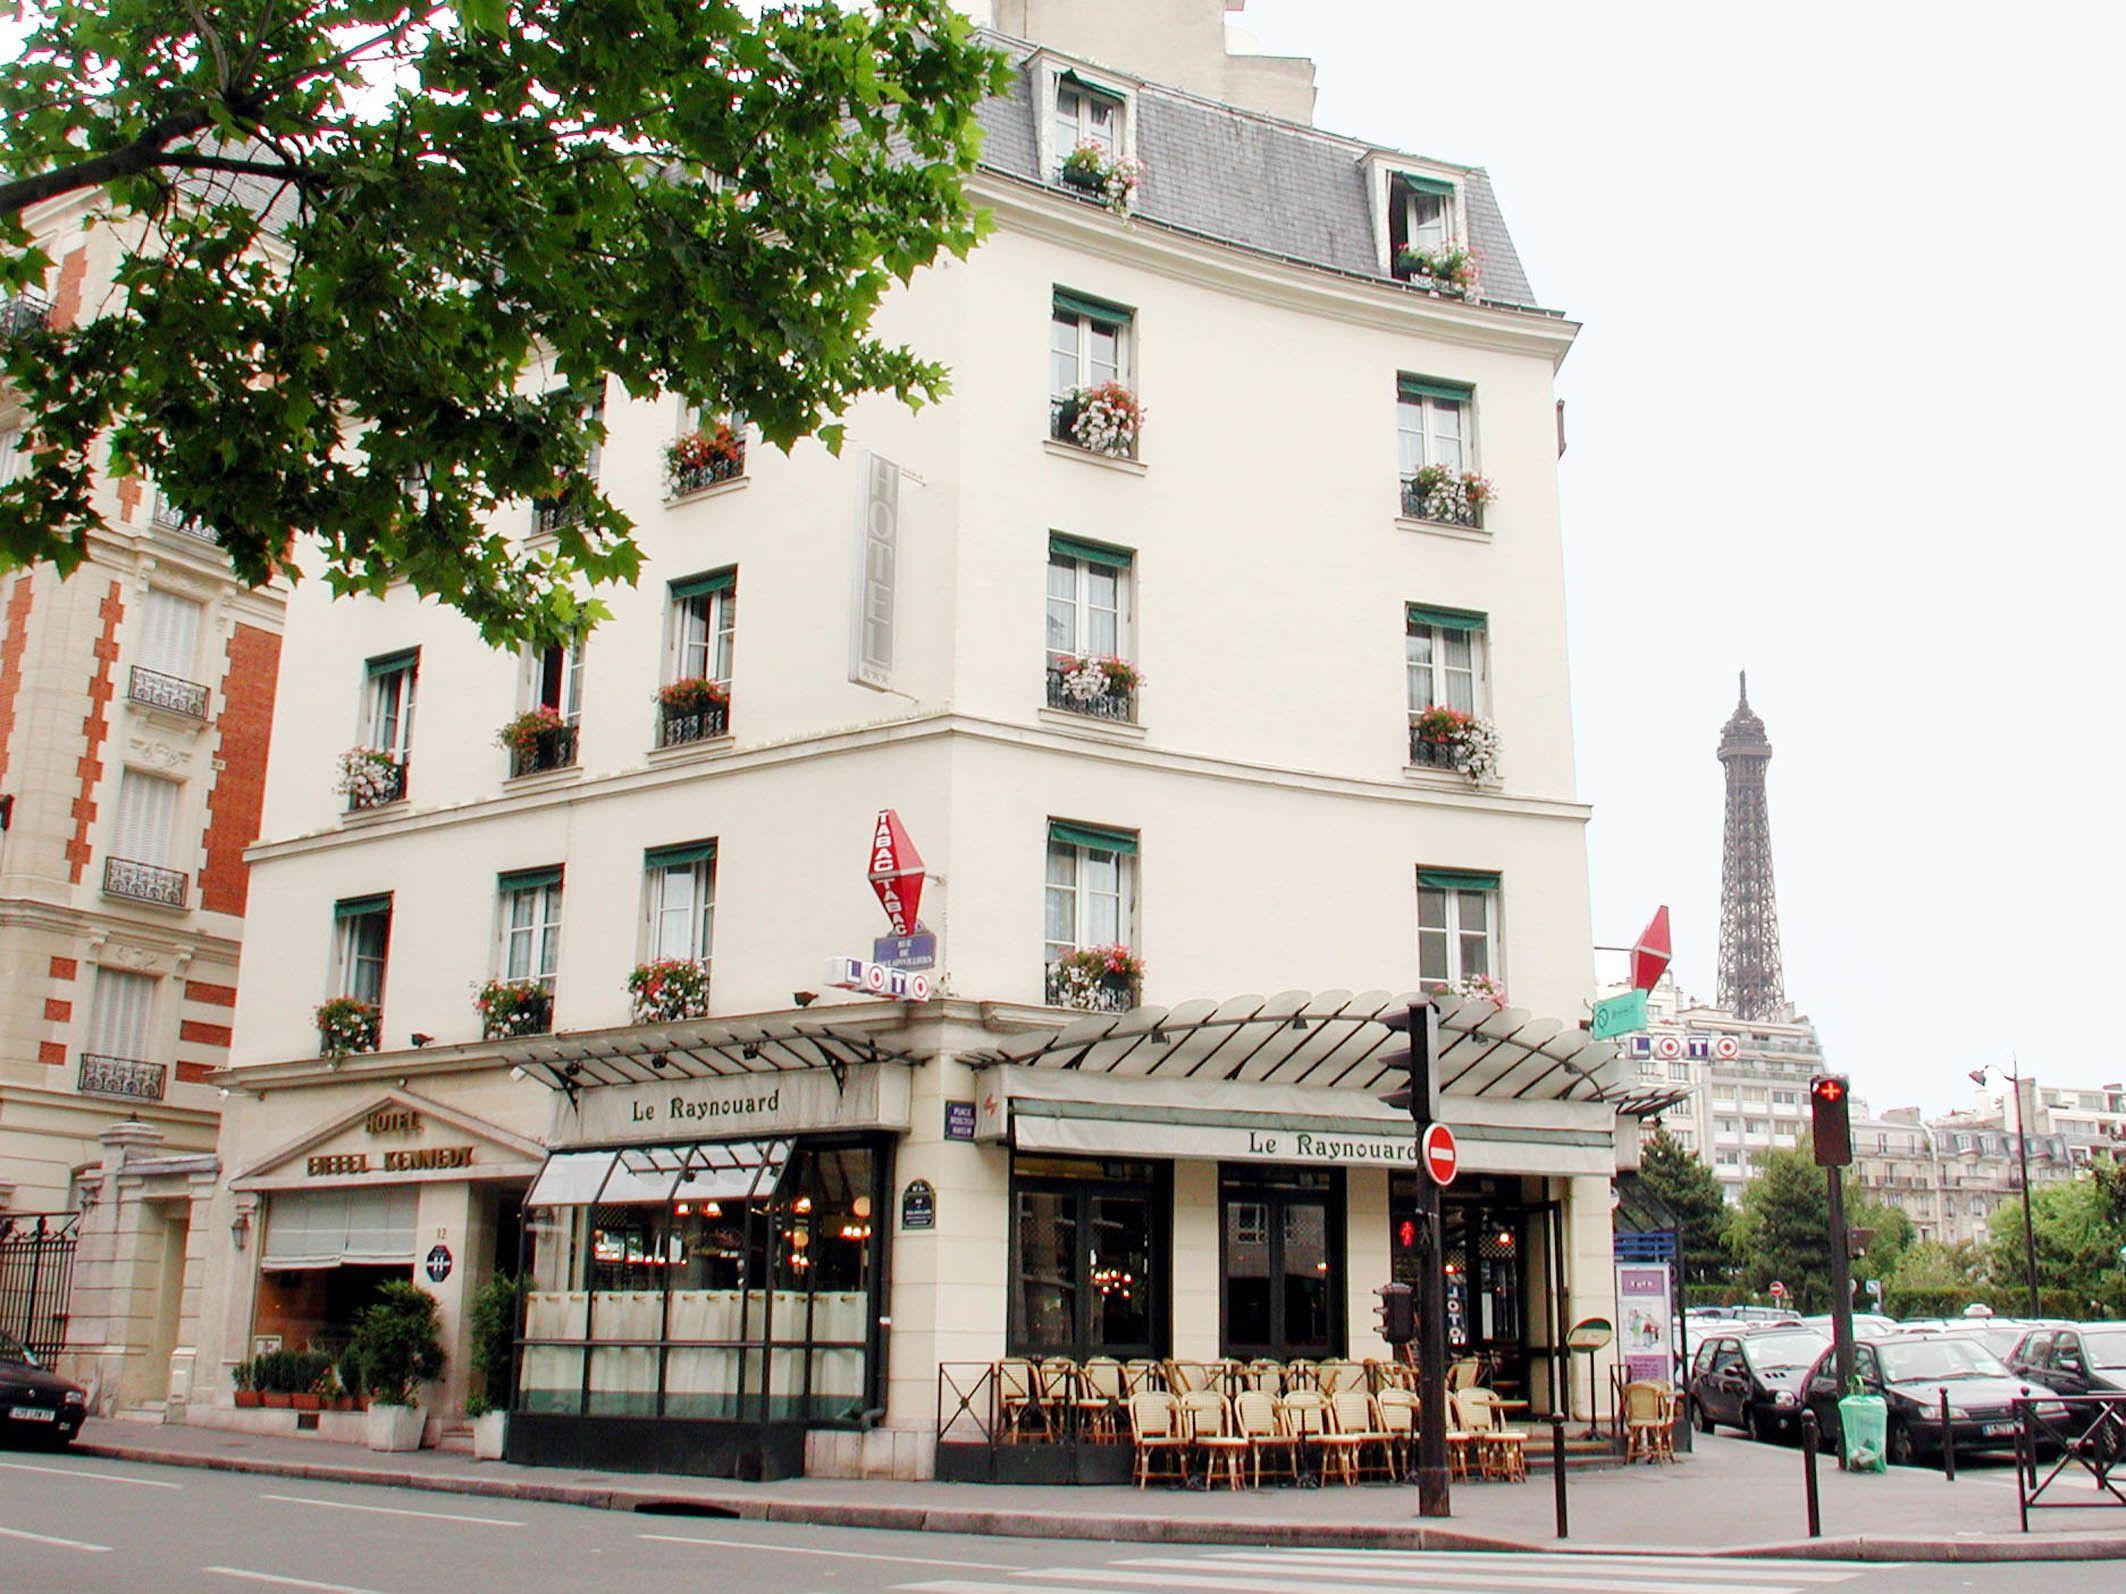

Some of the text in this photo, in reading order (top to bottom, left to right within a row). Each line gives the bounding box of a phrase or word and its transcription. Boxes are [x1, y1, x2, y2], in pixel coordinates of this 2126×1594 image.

[863, 456, 898, 671] HOTEL
[873, 811, 894, 871] TABAC
[876, 879, 907, 935] TABAC
[846, 959, 929, 1000] LOTO
[1631, 1037, 1738, 1059] LOTO
[632, 1088, 779, 1121] Le Raynouard
[366, 1111, 424, 1135] HOTEL
[1249, 1132, 1276, 1154] Le
[307, 1146, 473, 1176] EIFFEL KENNEDY
[433, 1256, 444, 1272] H
